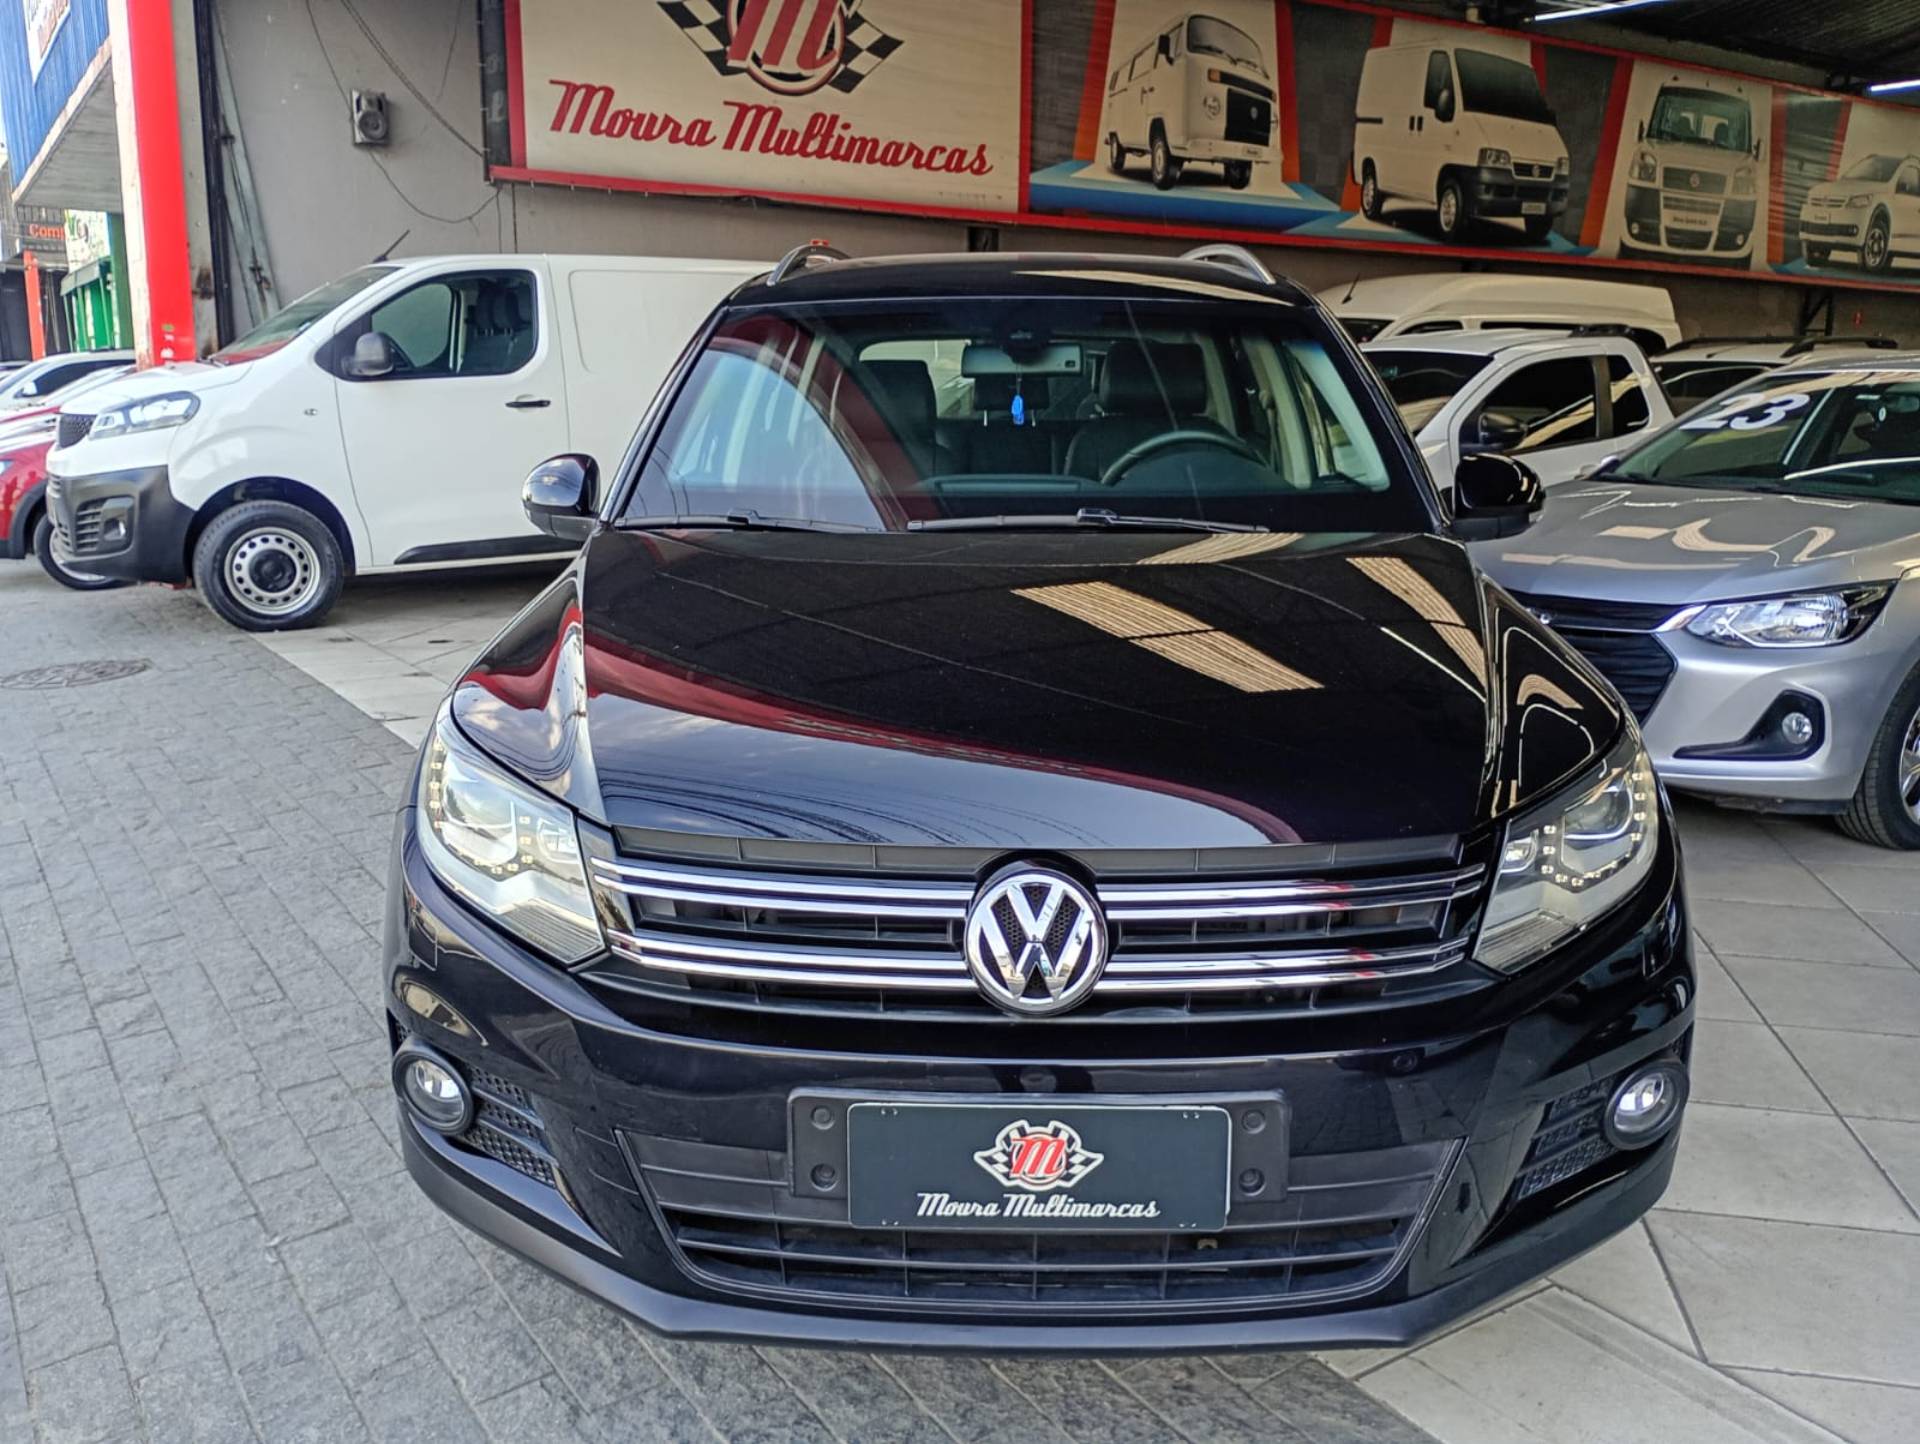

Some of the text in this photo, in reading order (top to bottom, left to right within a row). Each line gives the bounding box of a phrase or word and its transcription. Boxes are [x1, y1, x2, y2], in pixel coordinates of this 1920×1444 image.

[549, 79, 993, 176] Moura Multimarcas
[1678, 392, 1811, 430] 23
[972, 876, 1100, 1004] VW
[916, 1192, 1161, 1218] Moura Multimarcas
